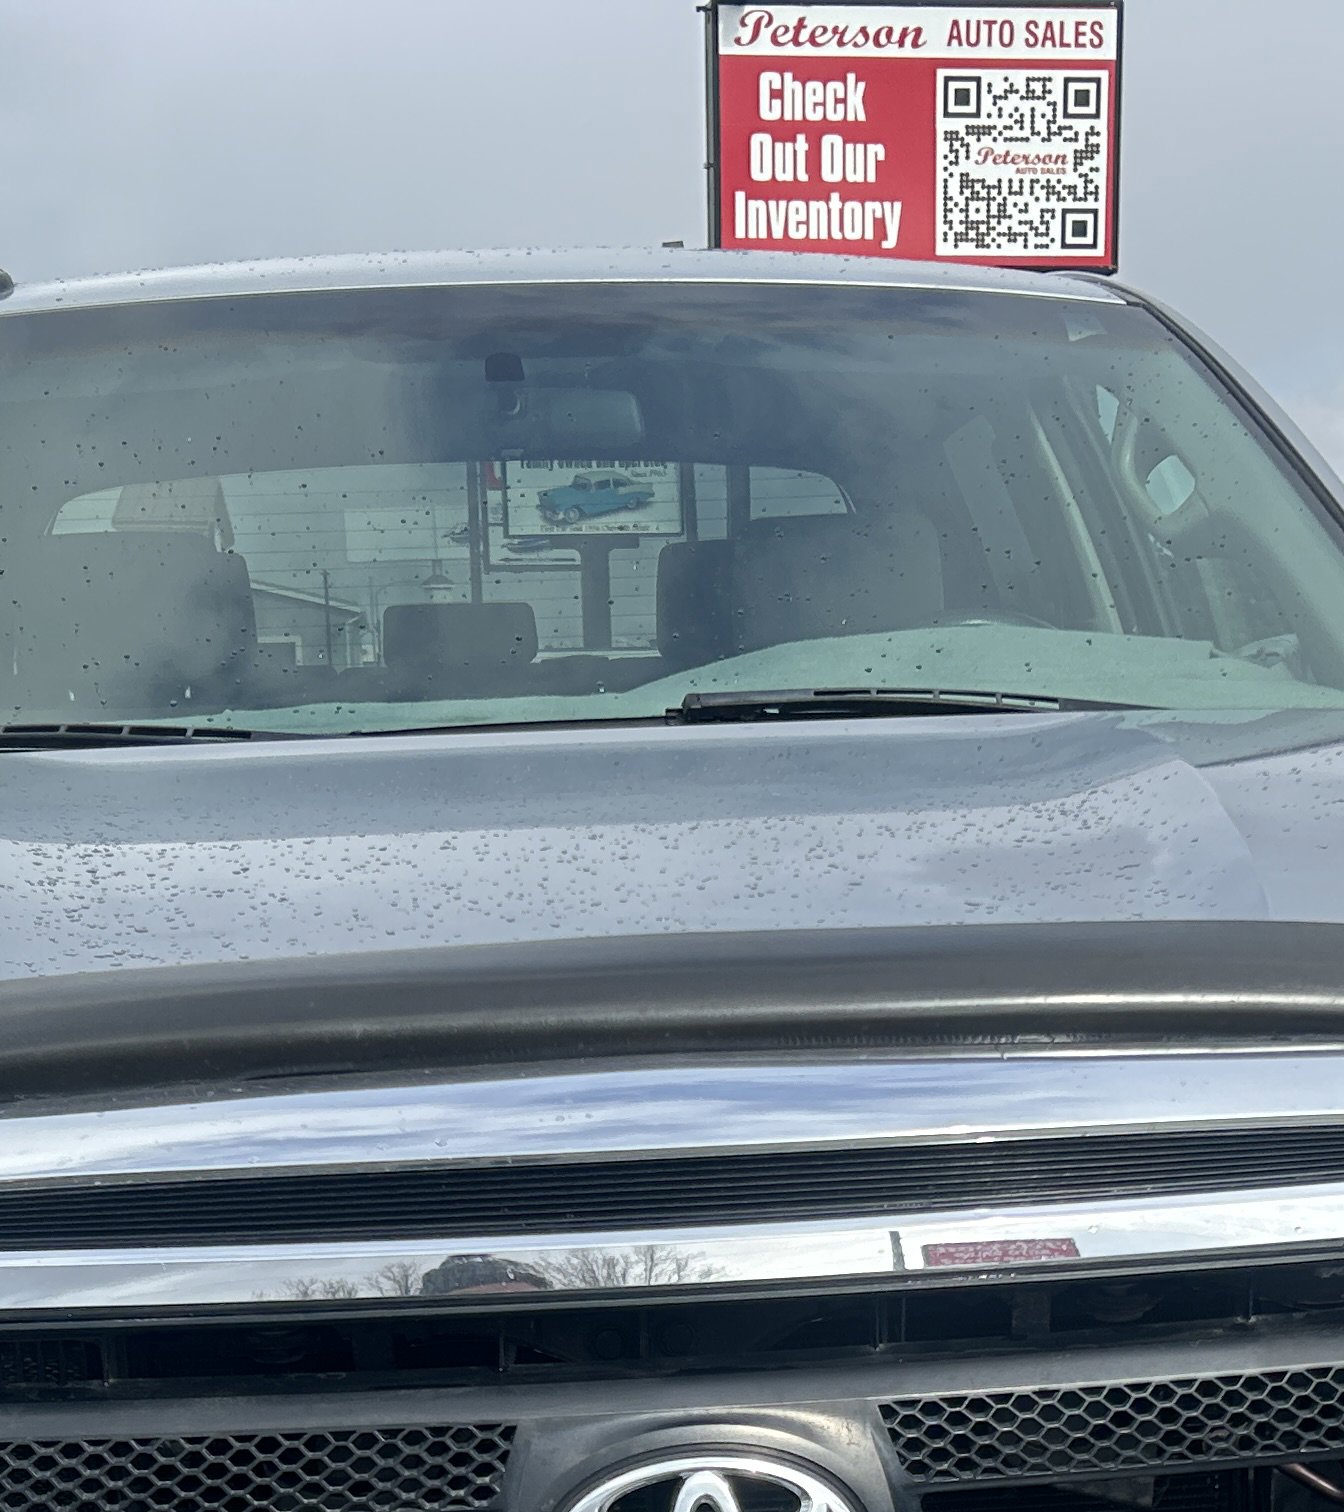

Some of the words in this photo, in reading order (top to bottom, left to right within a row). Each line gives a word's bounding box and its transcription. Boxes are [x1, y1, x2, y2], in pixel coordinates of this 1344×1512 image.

[733, 9, 927, 50] Peterson
[947, 19, 1016, 49] AUTO
[1024, 19, 1104, 49] SALES
[758, 71, 867, 122] Check
[750, 132, 809, 183] Out
[821, 133, 886, 183] Our
[974, 146, 1069, 165] Peterson
[734, 190, 903, 249] Inventory
